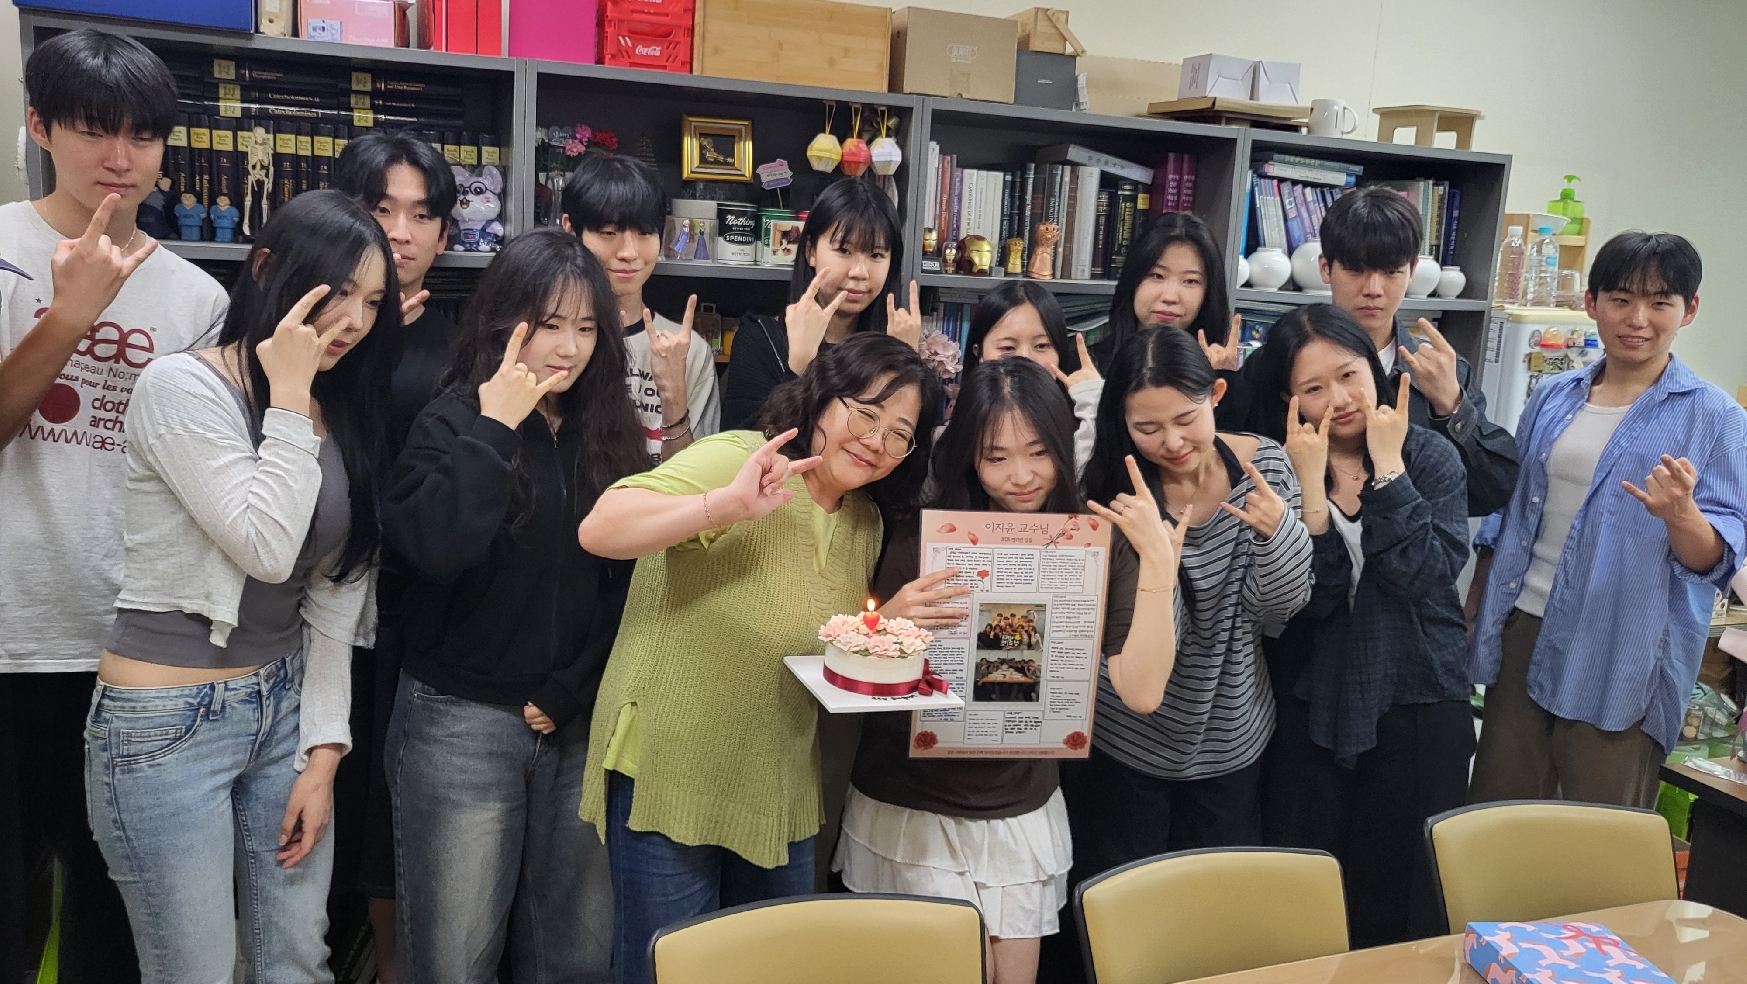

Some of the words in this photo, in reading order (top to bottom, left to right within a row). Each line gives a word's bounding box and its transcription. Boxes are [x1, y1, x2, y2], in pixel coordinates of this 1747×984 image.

[725, 215, 755, 228] Nothing
[80, 378, 100, 389] pour
[102, 379, 118, 391] les
[89, 415, 125, 434] arch
[985, 522, 1015, 534] 이지윤
[1018, 523, 1049, 534] 교수님
